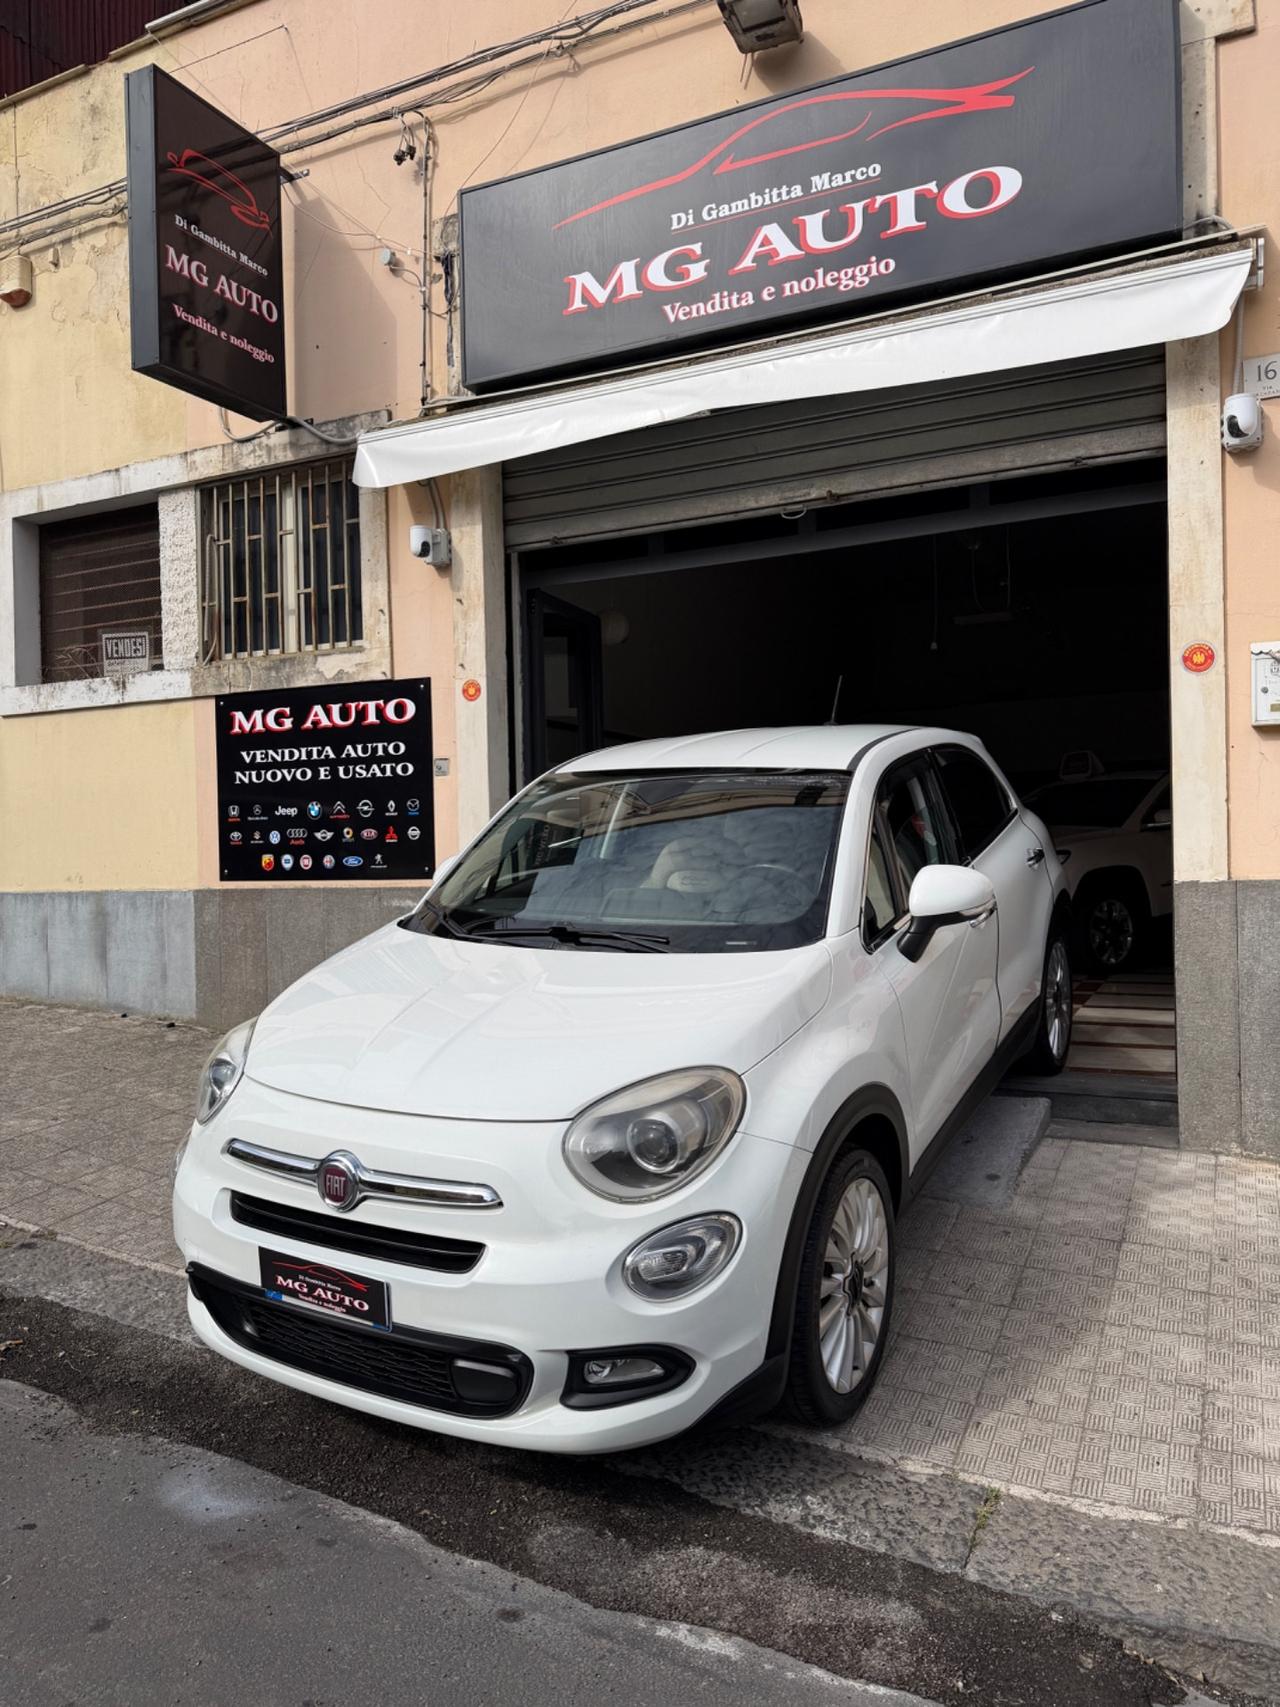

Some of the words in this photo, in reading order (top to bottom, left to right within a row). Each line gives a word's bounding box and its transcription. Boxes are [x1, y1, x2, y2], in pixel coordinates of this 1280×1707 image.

[671, 210, 695, 229] Di
[702, 184, 803, 221] Gambitta
[811, 163, 881, 193] Marco
[174, 214, 187, 230] Di
[190, 223, 237, 259] Gambitta
[239, 251, 269, 277] Marco
[563, 242, 710, 315] MG
[728, 166, 1023, 275] AUTO
[165, 244, 209, 288] MG
[214, 274, 279, 324] AUTO
[662, 290, 754, 323] Vendita
[761, 285, 776, 301] e
[781, 256, 896, 297] noleggio
[171, 303, 218, 336] Vendita
[220, 331, 228, 340] e
[229, 334, 275, 363] noleggio
[1257, 361, 1278, 381] 16
[106, 637, 146, 658] VENDESI
[230, 707, 294, 735] MG
[301, 697, 416, 730] AUTO
[240, 745, 336, 763] VENDITA
[341, 741, 406, 758] AUTO
[234, 767, 312, 785] NUOVO
[318, 766, 331, 781] E
[338, 762, 415, 779] USATO
[274, 805, 298, 818] Jeep
[326, 1174, 346, 1197] FIAT
[275, 1275, 308, 1294] MG
[313, 1287, 370, 1312] AUTO
